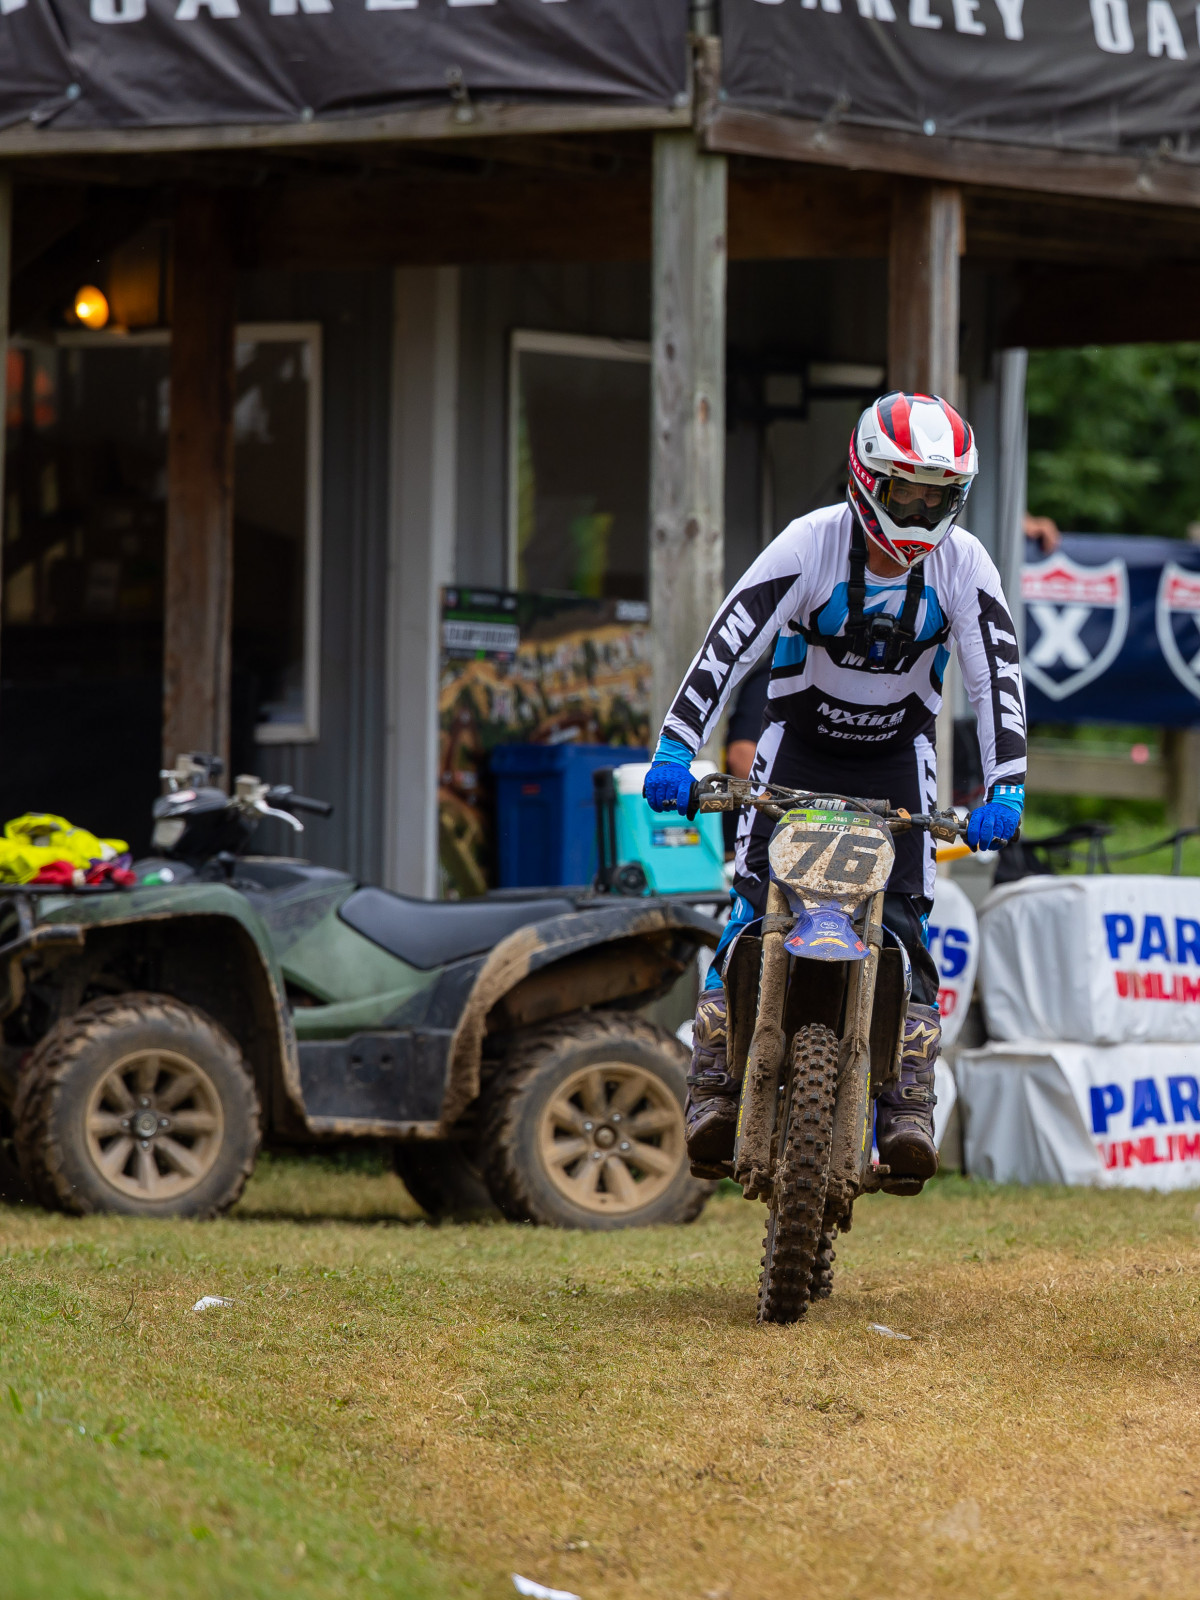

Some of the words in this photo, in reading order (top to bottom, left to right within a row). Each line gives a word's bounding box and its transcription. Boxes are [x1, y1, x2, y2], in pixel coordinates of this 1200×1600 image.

[684, 600, 757, 723] MXT
[829, 729, 899, 742] DUNLOP
[820, 823, 851, 833] FITCH
[784, 830, 887, 885] 76
